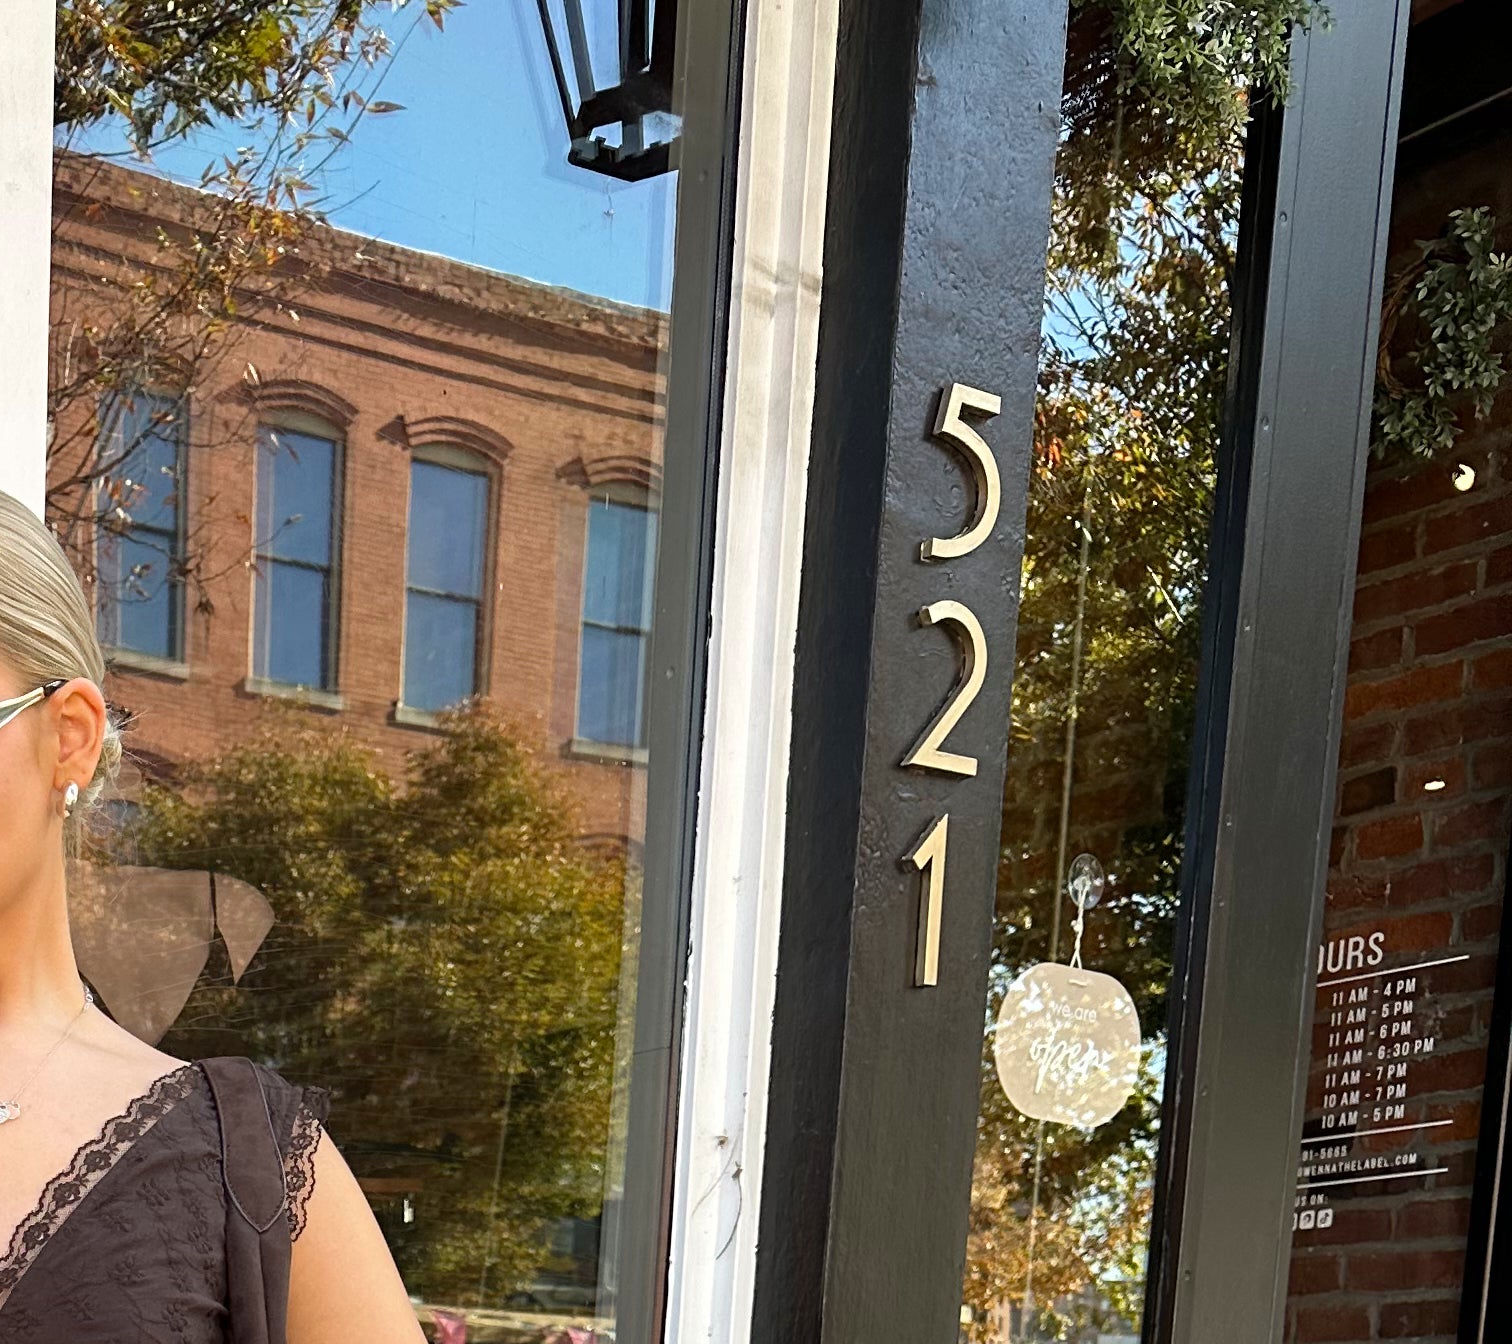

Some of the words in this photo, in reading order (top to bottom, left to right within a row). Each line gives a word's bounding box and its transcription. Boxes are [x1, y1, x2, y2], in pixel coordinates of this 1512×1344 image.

[901, 382, 1001, 987] 521
[1332, 992, 1344, 1007] 11
[1348, 986, 1368, 1004] AM
[1384, 982, 1392, 997] 4
[1396, 977, 1416, 995] PM
[1052, 1003, 1071, 1016] we
[1074, 1007, 1097, 1021] are
[1330, 1011, 1342, 1027] 11
[1346, 1007, 1366, 1024] AM
[1381, 1003, 1390, 1018] 5
[1393, 1000, 1413, 1016] PM
[1328, 1032, 1340, 1047] 11
[1344, 1028, 1365, 1045] AM
[1379, 1024, 1388, 1039] 6
[1391, 1020, 1411, 1037] PM
[1327, 1053, 1338, 1068] 11
[1342, 1049, 1363, 1066] AM
[1377, 1042, 1410, 1060] 6:30
[1414, 1037, 1434, 1054] PM
[1325, 1073, 1336, 1089] 11
[1340, 1069, 1361, 1086] AM
[1376, 1066, 1384, 1081] 7
[1387, 1062, 1407, 1079] PM
[1323, 1094, 1337, 1109] 10
[1340, 1090, 1360, 1107] AM
[1375, 1086, 1383, 1102] 7
[1387, 1083, 1406, 1100] PM
[1321, 1114, 1335, 1129] 10
[1338, 1110, 1358, 1127] AM
[1373, 1107, 1381, 1122] 5
[1385, 1104, 1405, 1120] PM
